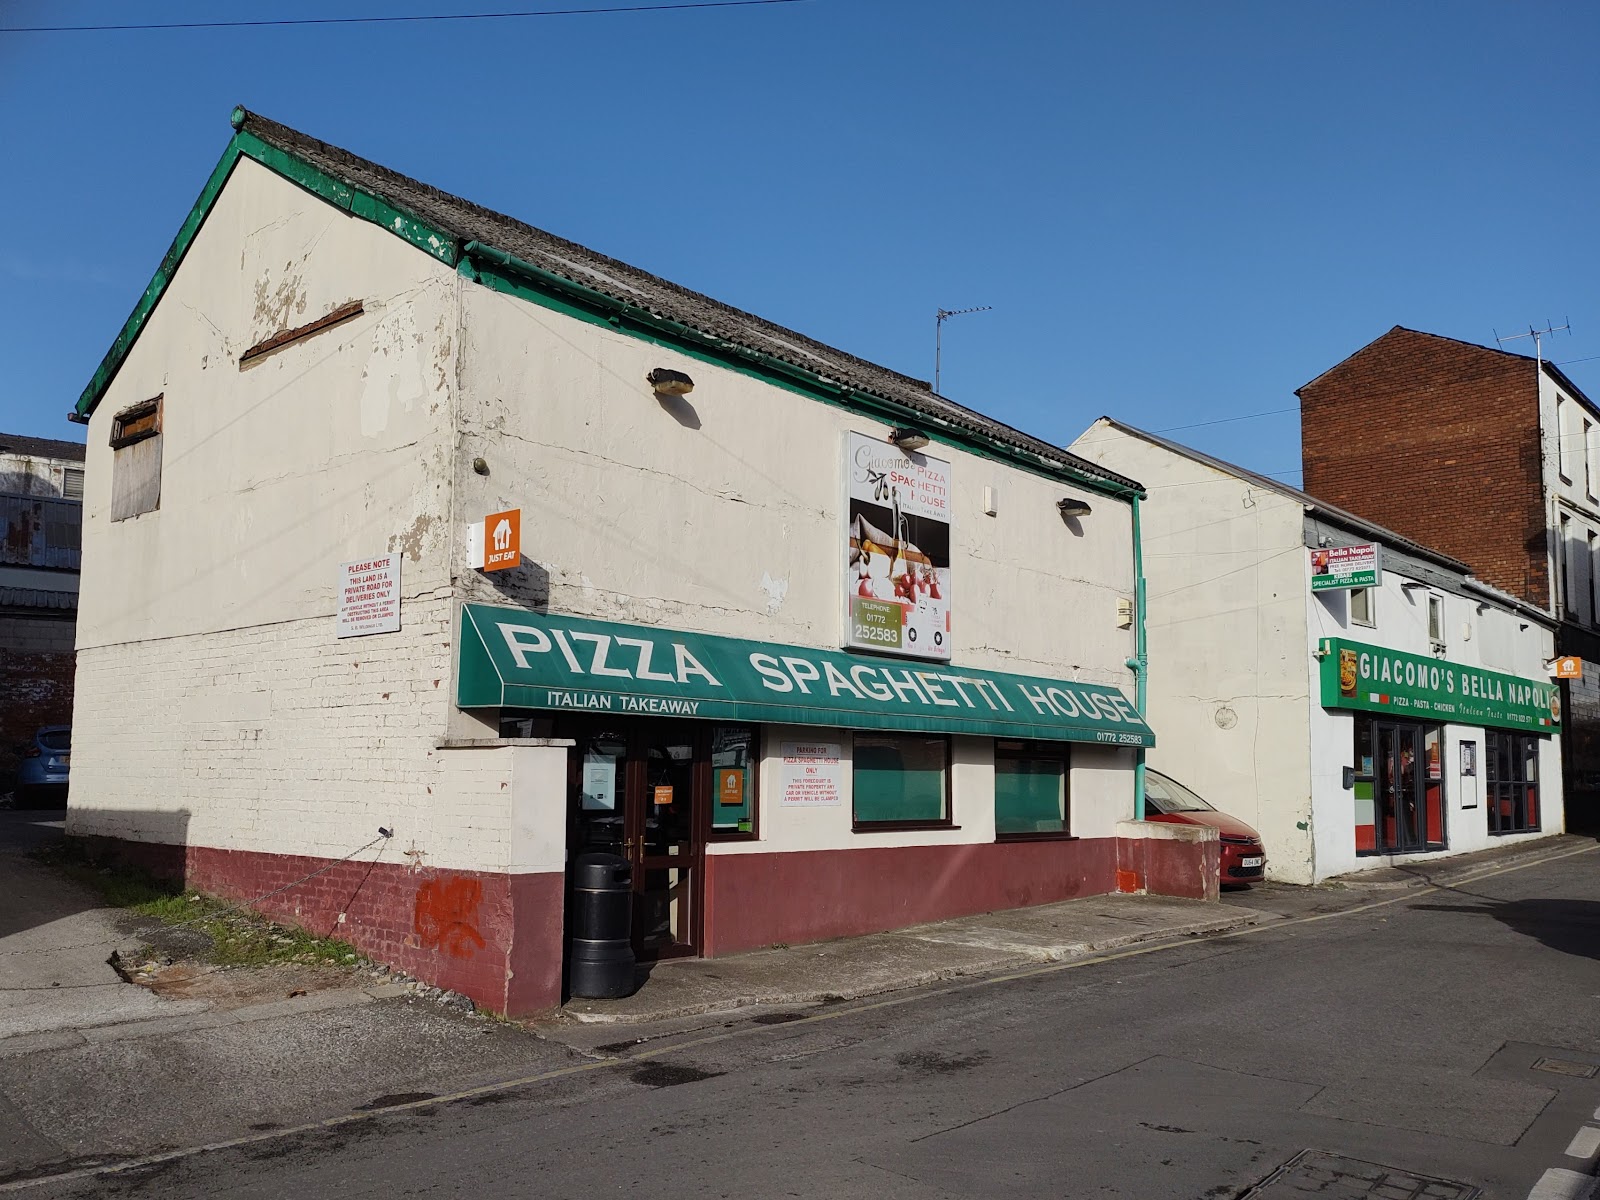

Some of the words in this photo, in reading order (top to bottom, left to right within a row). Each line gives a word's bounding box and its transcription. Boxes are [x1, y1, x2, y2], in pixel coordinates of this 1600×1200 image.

[854, 445, 916, 483] Giacomo's
[918, 467, 945, 483] PIZZA
[890, 471, 946, 496] SPAGHETTI
[488, 553, 503, 564] JUST
[504, 551, 516, 560] EAT
[1350, 546, 1374, 555] Napoli
[348, 562, 371, 573] PLEASE
[373, 559, 390, 569] NOTE
[350, 577, 361, 585] THIS
[363, 574, 376, 582] LAND
[345, 585, 365, 595] PRIVATE
[366, 583, 380, 591] ROAD
[346, 594, 375, 603] DELIVERIES
[377, 590, 390, 598] ONLY
[867, 614, 885, 623] 01772
[856, 624, 897, 642] 252583
[495, 622, 723, 687] PIZZA
[749, 652, 1014, 713] SPAGHETTI
[1021, 684, 1145, 726] HOUSE
[1360, 652, 1453, 693] GIACOMO'S
[1462, 673, 1503, 701] BELLA
[1509, 683, 1550, 709] NAPOLI
[547, 691, 611, 709] ITALIAN
[619, 696, 700, 715] TAKEAWAY
[1394, 696, 1409, 707] PIZZA
[1414, 699, 1429, 709] PASTA
[1434, 702, 1455, 713] CHICKEN
[1096, 732, 1117, 742] 01772
[1118, 734, 1143, 744] 252583
